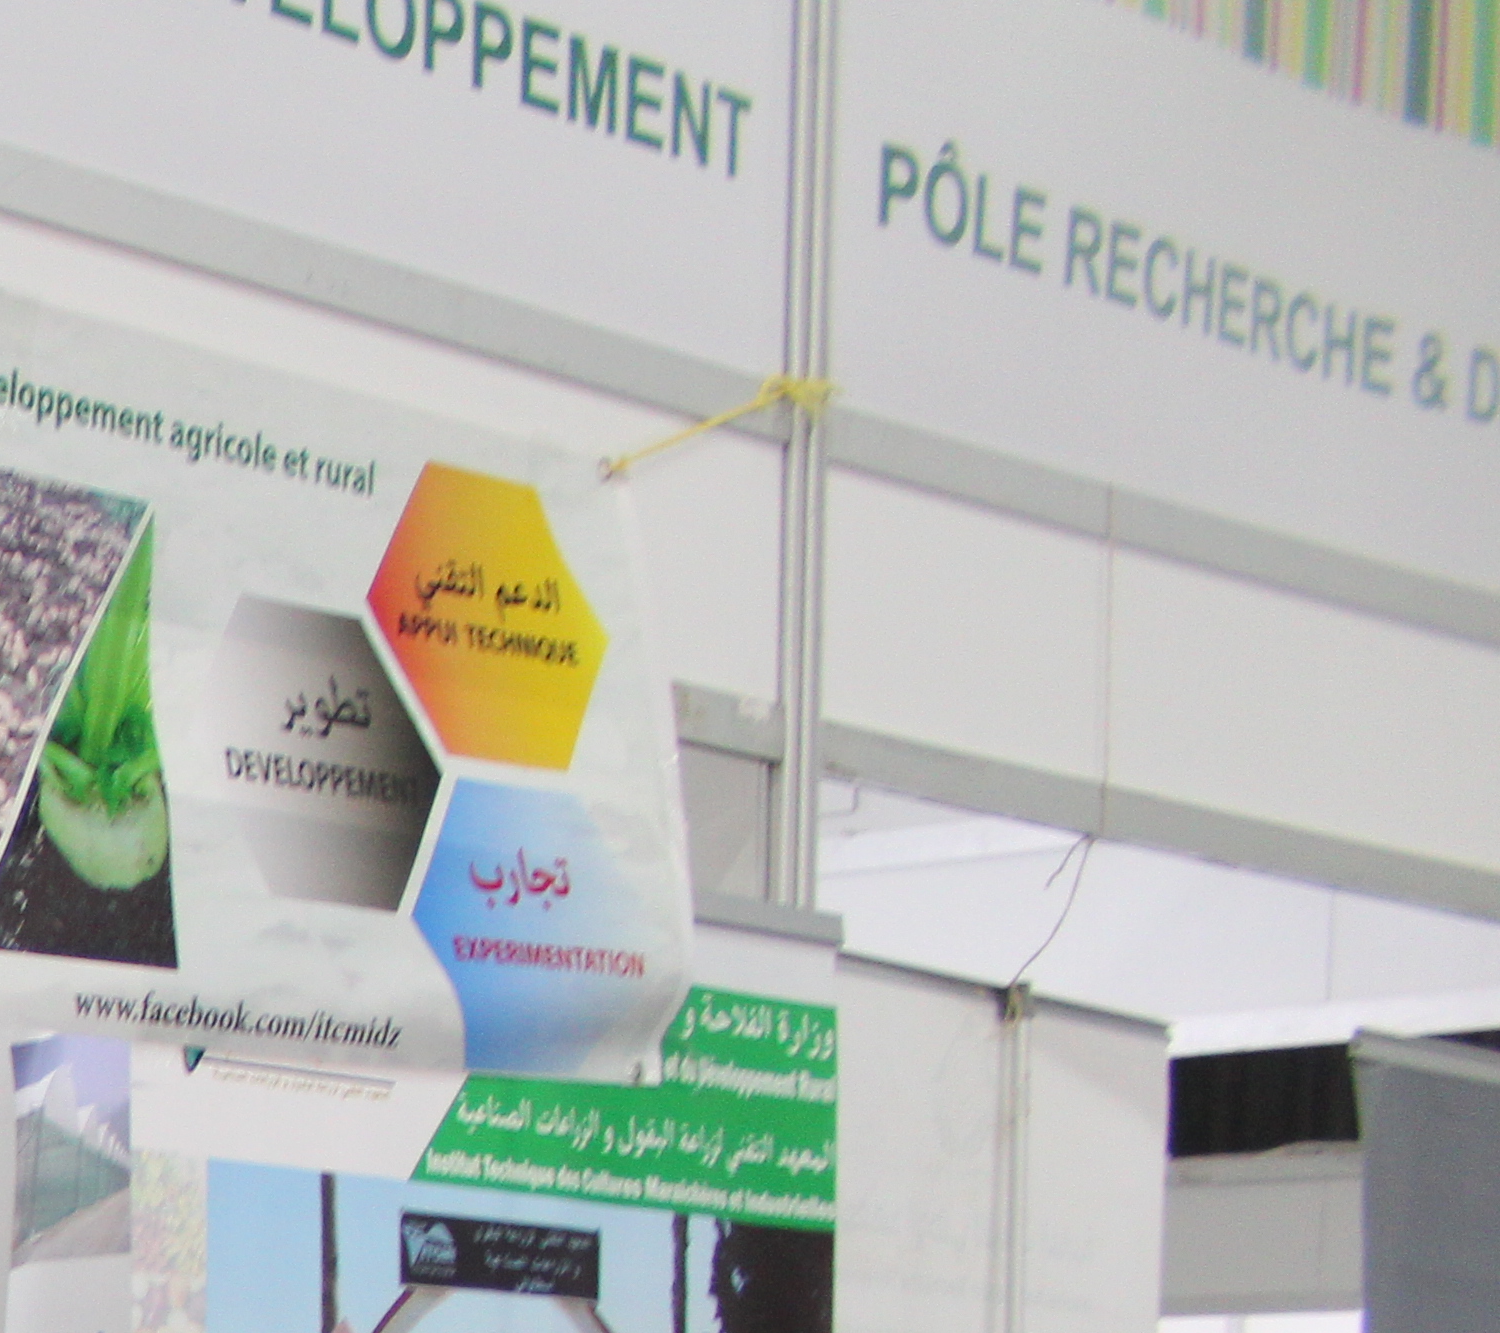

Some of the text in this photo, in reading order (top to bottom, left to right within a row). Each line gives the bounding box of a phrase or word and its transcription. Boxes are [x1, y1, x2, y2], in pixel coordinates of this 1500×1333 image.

[271, 0, 753, 178] LOPPEMENT
[878, 139, 1446, 410] PÔLE RECHERCHE &
[169, 423, 276, 470] agricole
[283, 446, 308, 476] et
[315, 458, 377, 498] rural
[414, 558, 561, 622] الدعم التقني
[399, 612, 580, 668] APPUI TECHNIQUE
[281, 673, 373, 737] تطوير
[469, 846, 570, 911] تجارب
[453, 934, 646, 979] EXPERIMENTATION
[74, 988, 404, 1051] www.facebook.com/itcmidz
